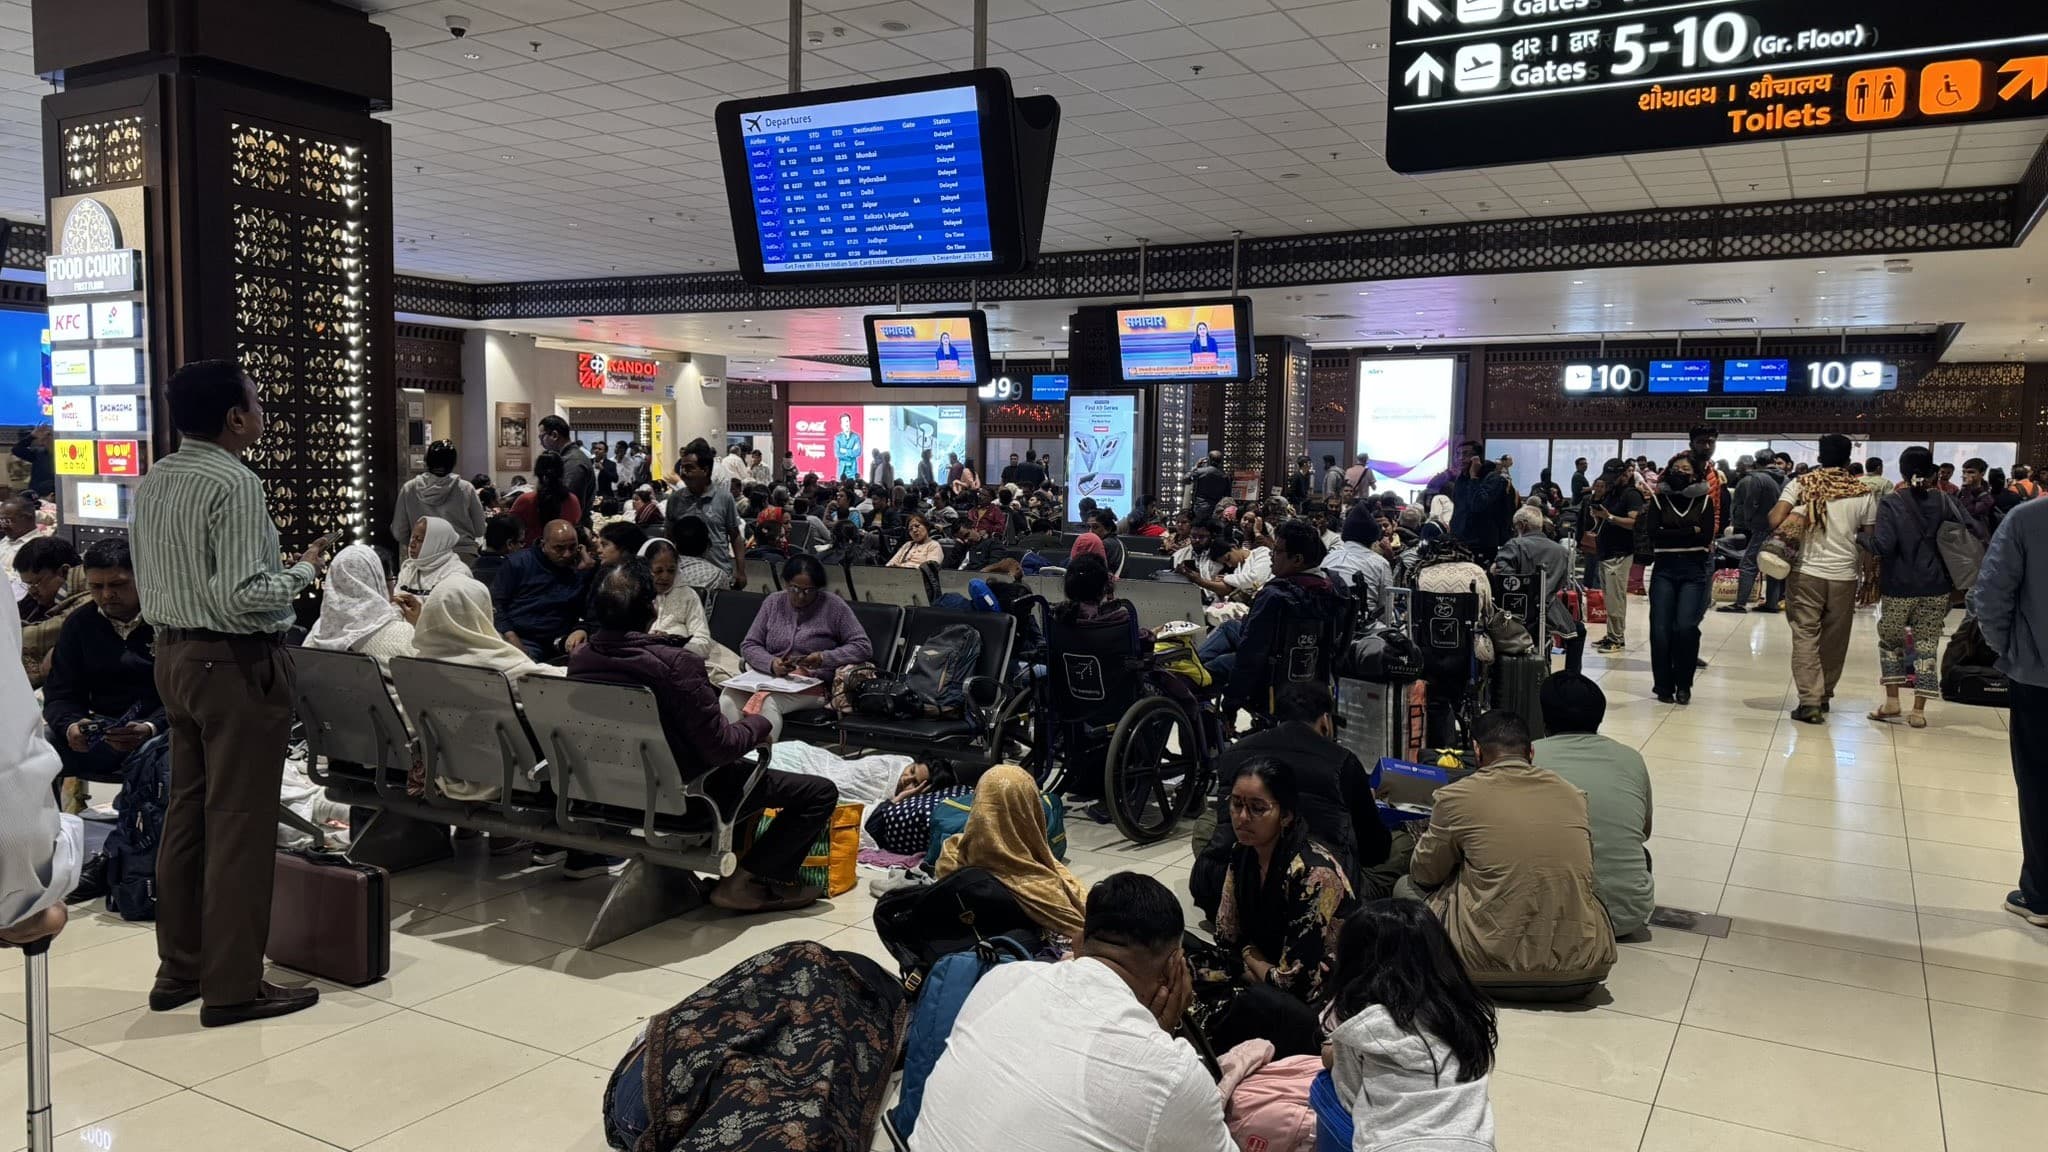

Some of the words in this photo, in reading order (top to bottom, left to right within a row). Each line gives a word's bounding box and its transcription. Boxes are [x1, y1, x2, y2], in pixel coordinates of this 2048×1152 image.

[1511, 60, 1585, 86] Gates
[1611, 12, 1748, 75] 5-10
[1754, 34, 1793, 58] (Gr.
[1797, 25, 1863, 50] Floor)
[1748, 73, 1833, 100] शौचालय
[765, 115, 812, 129] Departures
[1728, 104, 1831, 133] Toilets
[853, 125, 884, 134] Destination
[902, 121, 915, 129] Gate
[933, 130, 953, 138] Delayed
[855, 151, 877, 159] Mumbai
[936, 156, 956, 164] Delayed
[859, 175, 887, 184] Hyderabad
[937, 168, 957, 176] Delayed
[49, 257, 83, 281] FOOD
[85, 252, 129, 278] COURT
[55, 315, 80, 331] KFC
[1125, 315, 1163, 328] समाचार
[608, 360, 658, 376] KANDOI
[1807, 361, 1846, 389] 10
[1596, 364, 1631, 390] 10
[105, 442, 131, 459] WOW!
